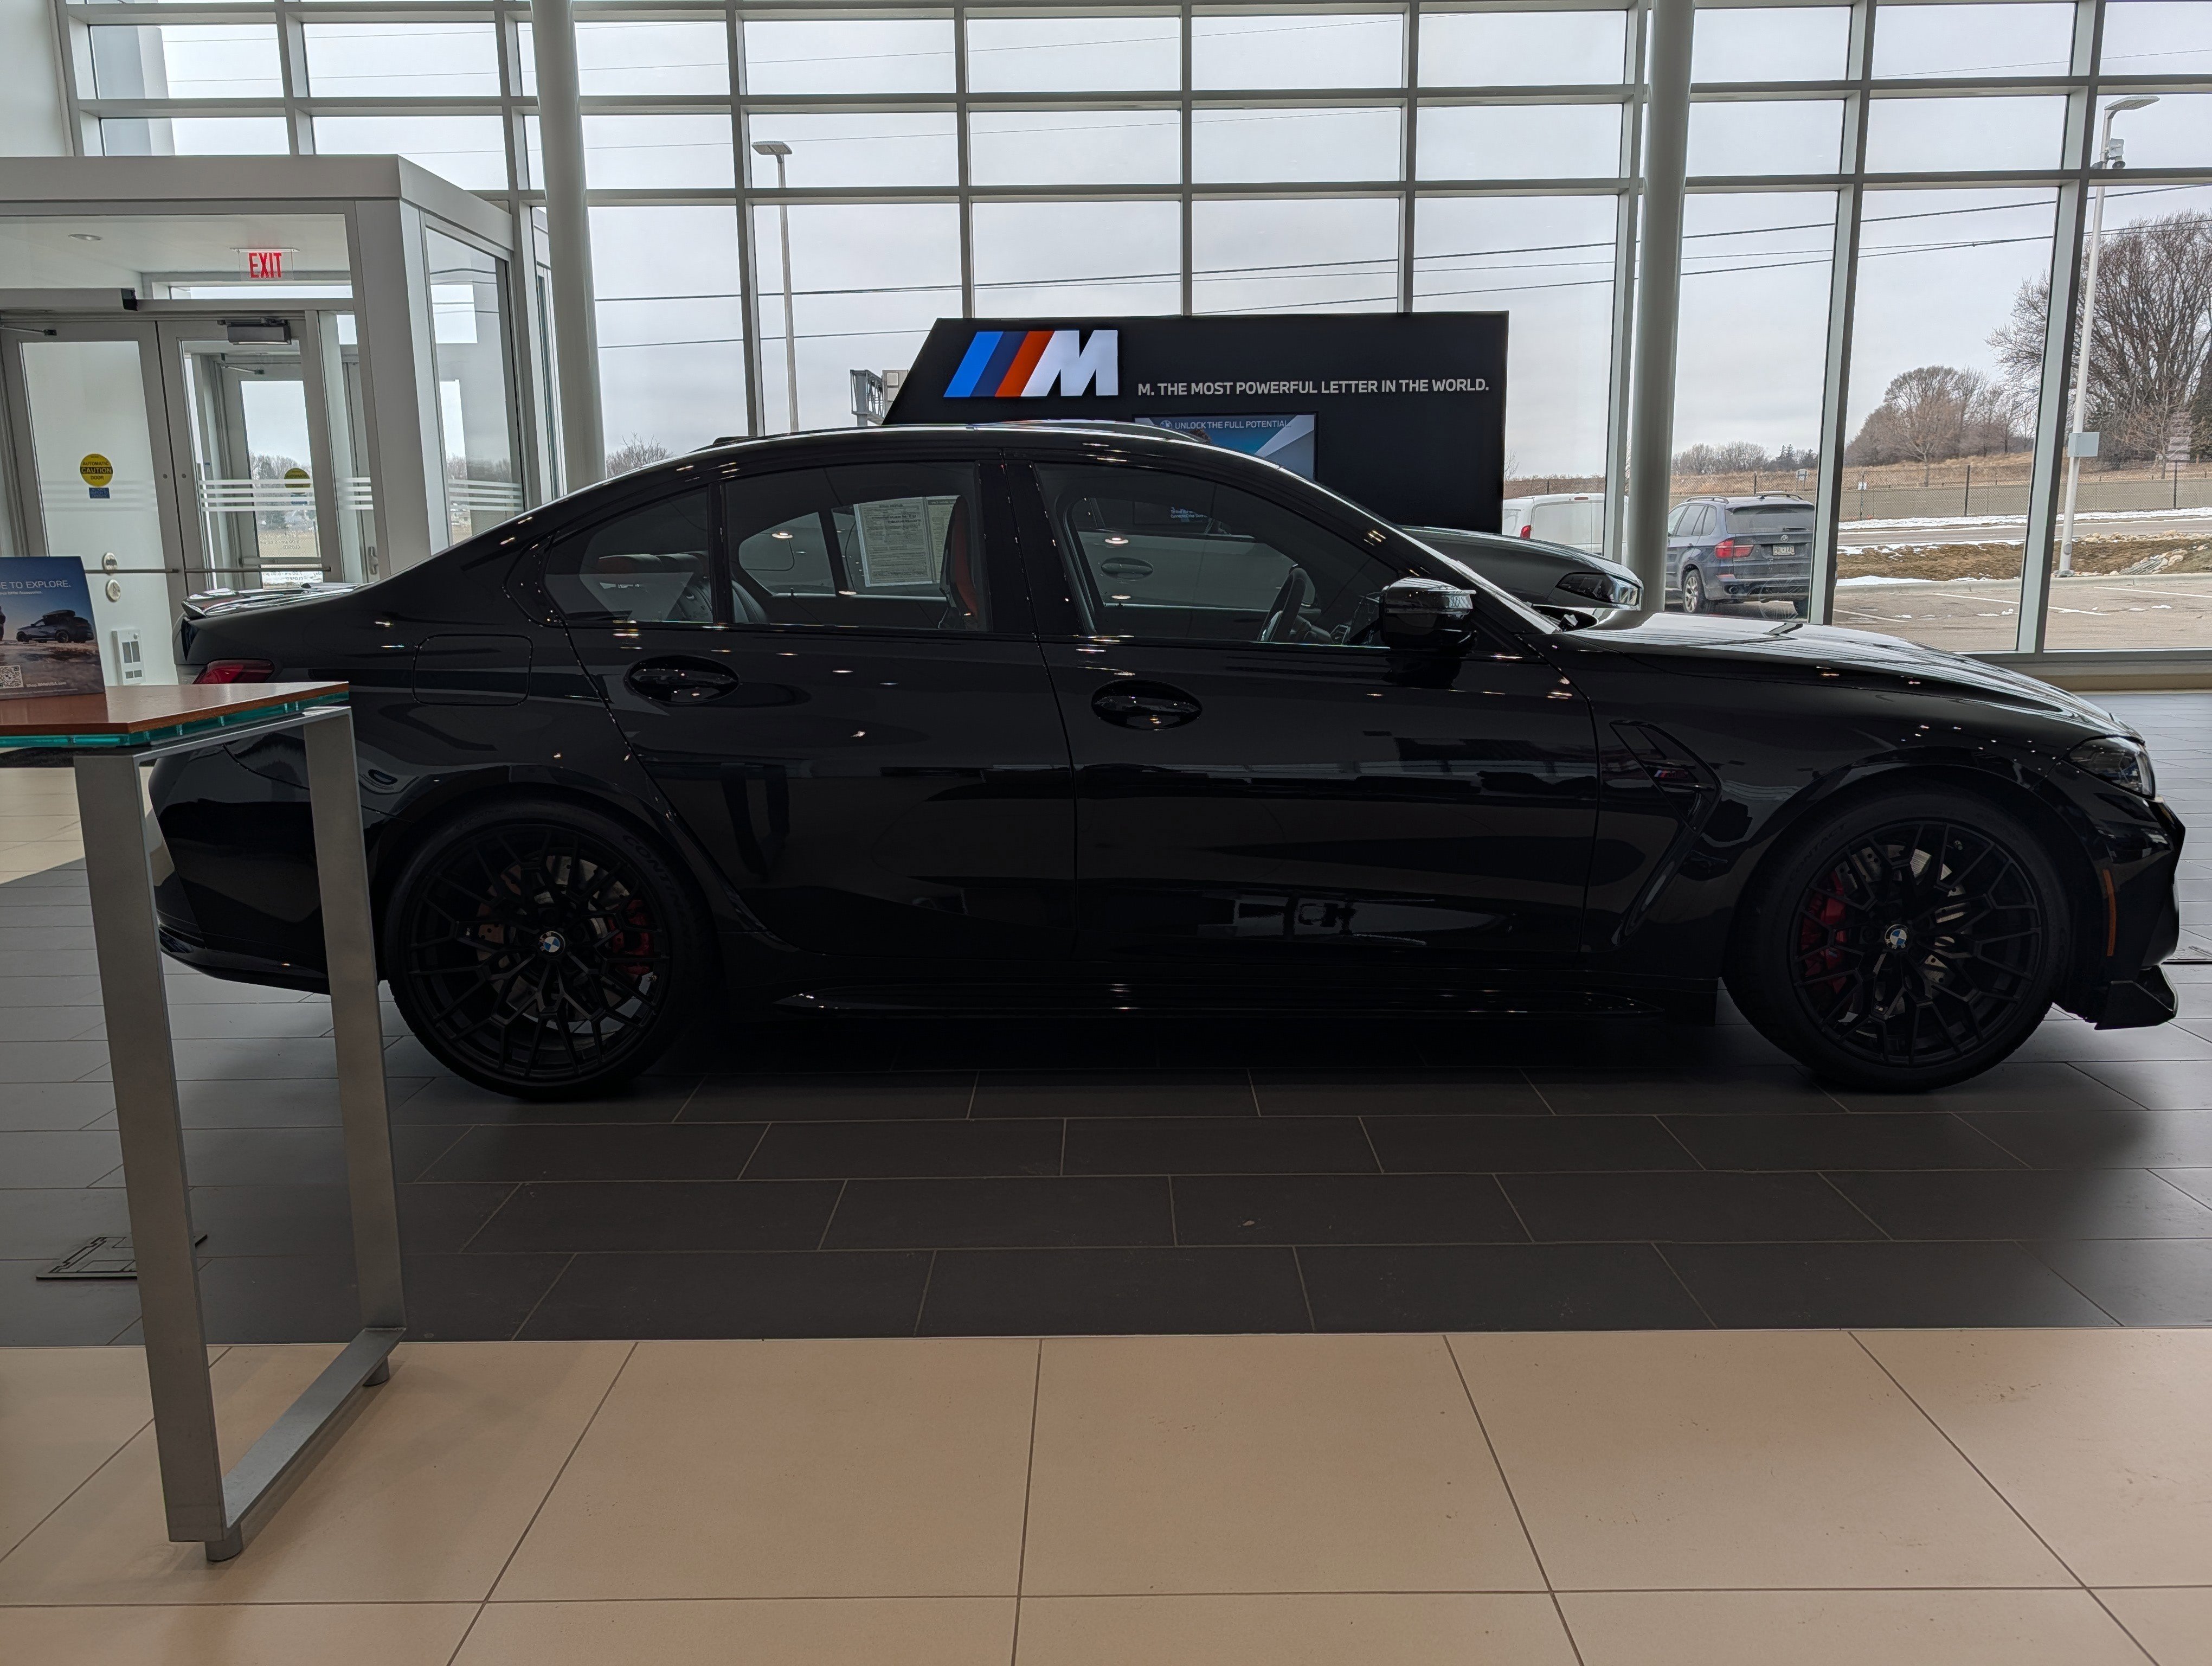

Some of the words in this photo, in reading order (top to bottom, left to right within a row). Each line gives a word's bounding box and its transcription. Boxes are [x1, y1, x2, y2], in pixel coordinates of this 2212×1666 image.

[248, 253, 282, 278] EXIT
[1138, 383, 1155, 396] M.
[1158, 382, 1187, 395] THE
[1191, 382, 1233, 395] MOST
[1236, 381, 1318, 394] POWERFUL
[1321, 381, 1378, 394] LETTER
[1381, 380, 1396, 393] IN
[1399, 380, 1429, 392] THE
[1432, 379, 1489, 392] WORLD.
[1174, 421, 1207, 430] UNLOCK
[1246, 420, 1291, 428] POTENTIAL.
[26, 580, 71, 589] EXPLORE.
